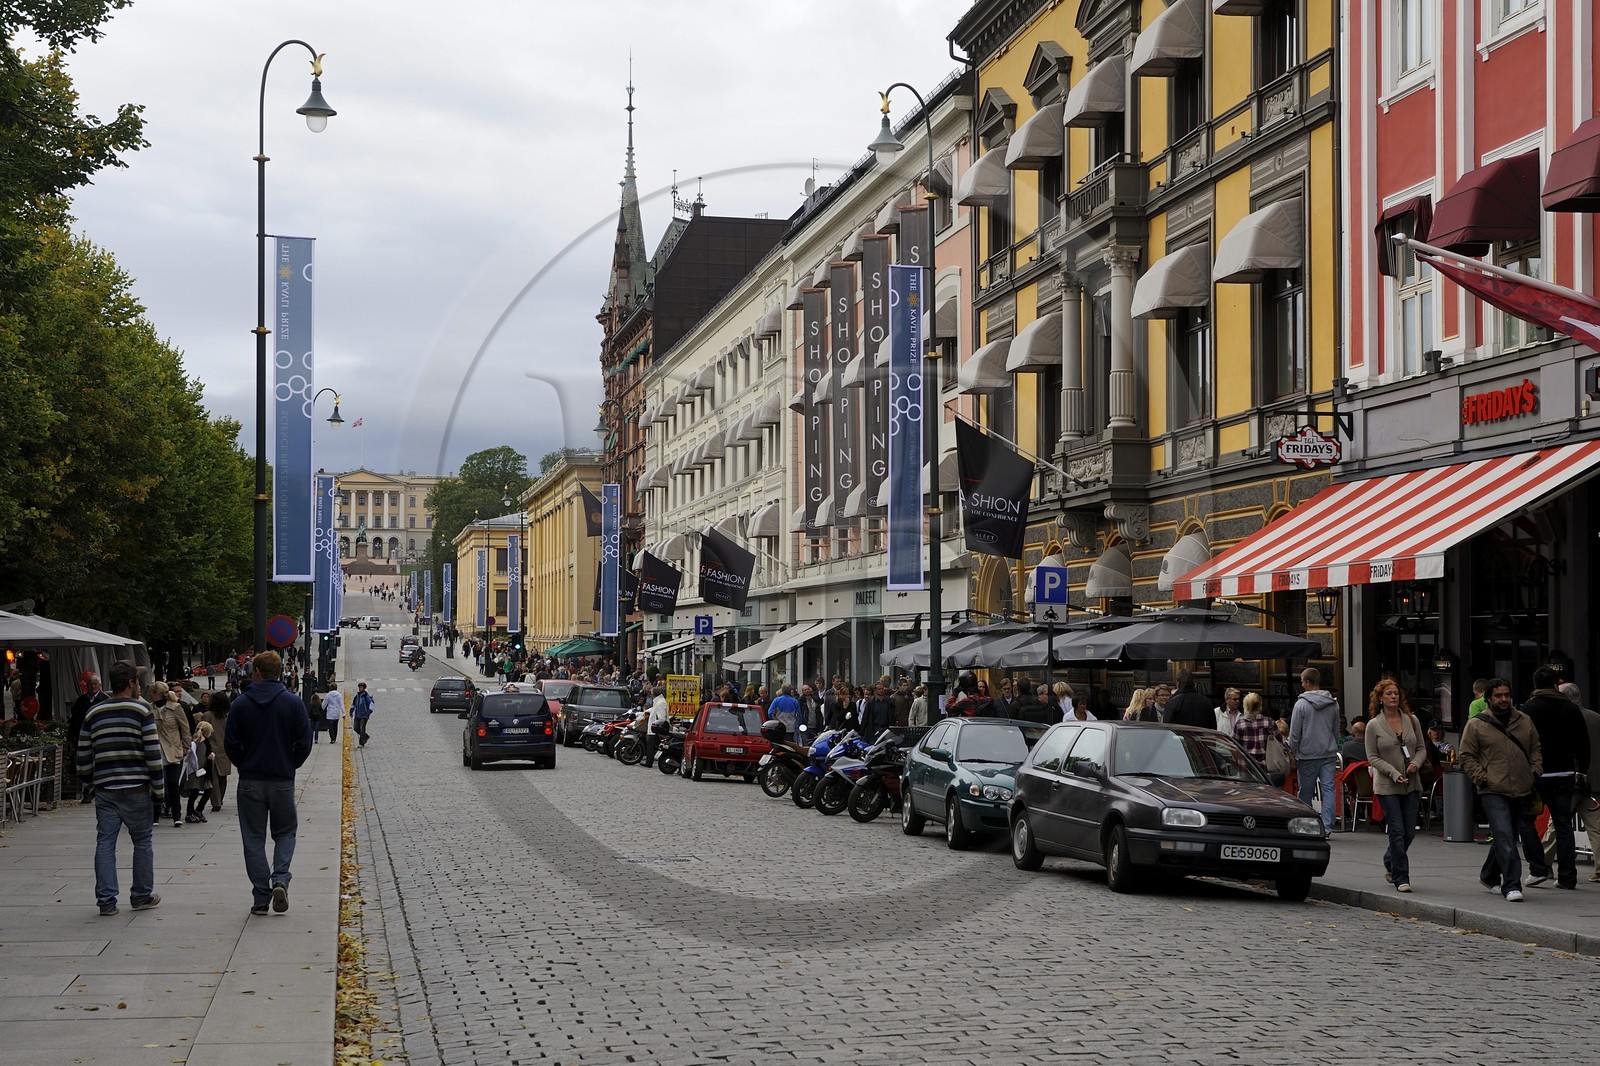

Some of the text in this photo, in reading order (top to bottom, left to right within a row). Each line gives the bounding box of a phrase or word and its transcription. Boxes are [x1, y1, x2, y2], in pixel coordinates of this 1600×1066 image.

[1286, 444, 1332, 454] FRIDAY'S
[706, 568, 746, 585] FASHION
[642, 582, 675, 596] FASHION
[1044, 572, 1060, 598] P
[856, 590, 876, 605] PALEET
[700, 618, 709, 633] P
[678, 692, 688, 702] IS
